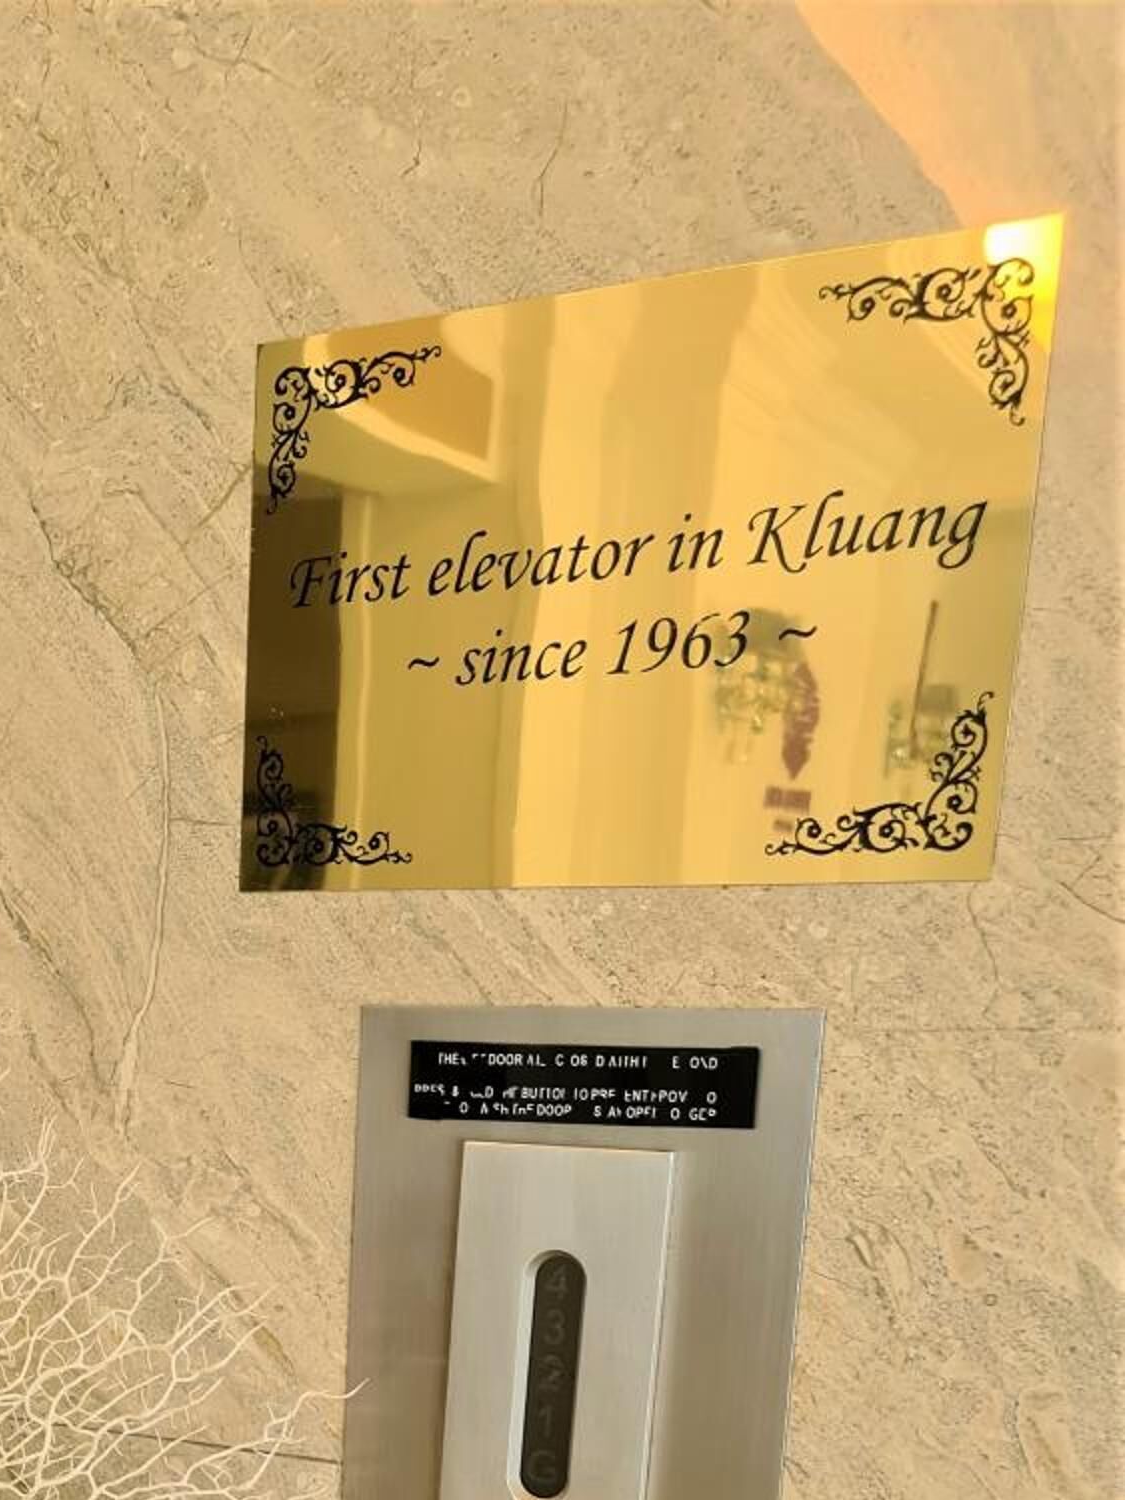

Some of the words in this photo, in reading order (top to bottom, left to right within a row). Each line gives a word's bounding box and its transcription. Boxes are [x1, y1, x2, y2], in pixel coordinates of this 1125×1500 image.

[289, 551, 411, 608] First
[427, 530, 655, 597] elevator
[667, 513, 724, 573] in
[747, 489, 988, 573] Kluang
[455, 629, 587, 686] since
[606, 609, 751, 676] 1963
